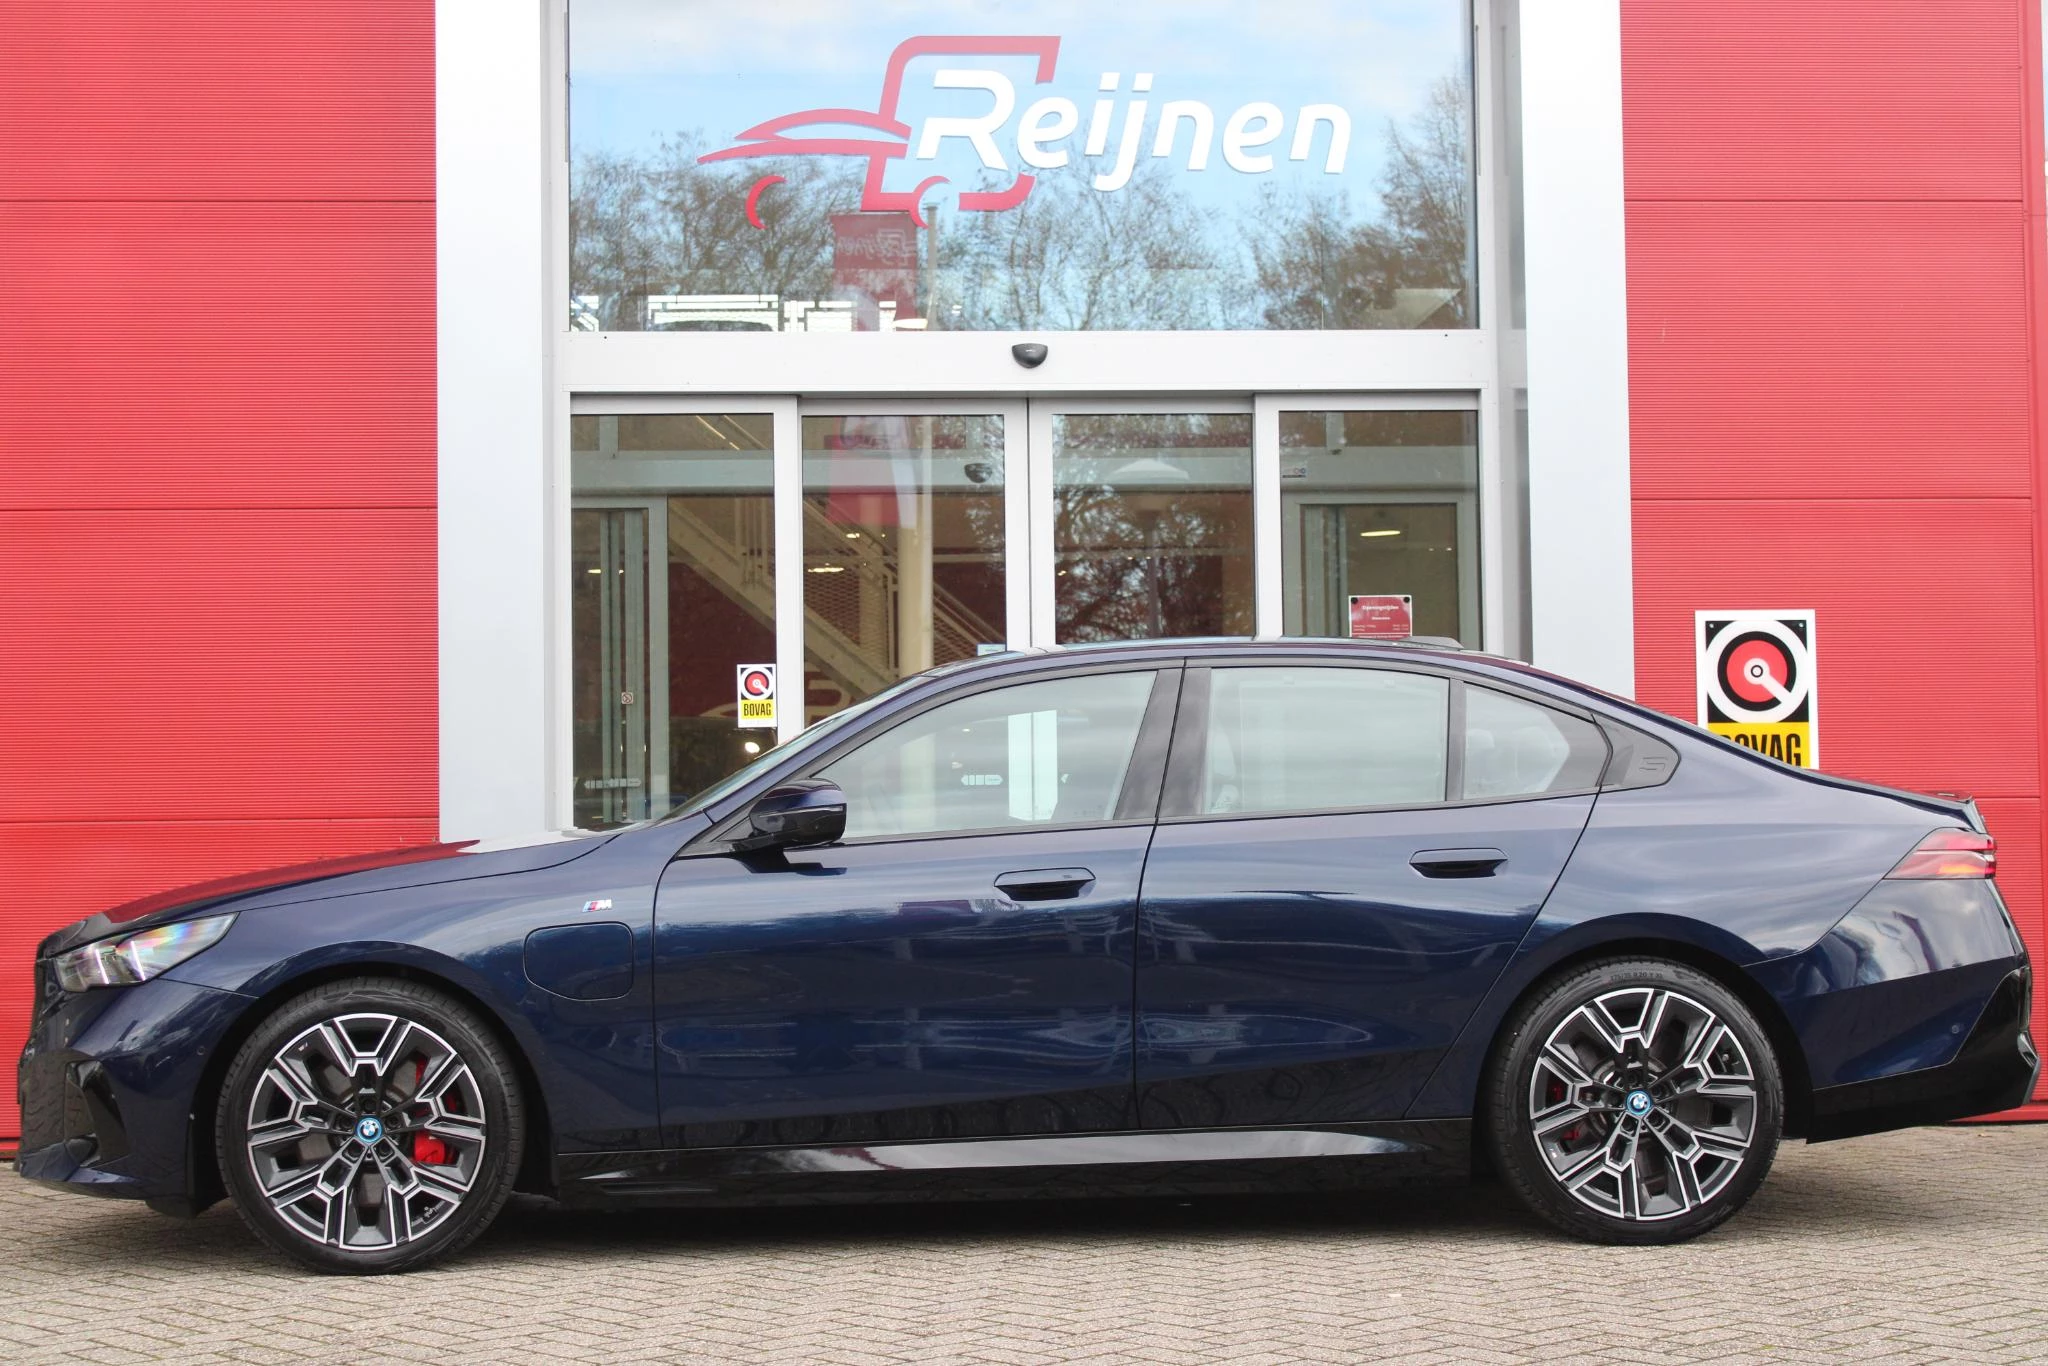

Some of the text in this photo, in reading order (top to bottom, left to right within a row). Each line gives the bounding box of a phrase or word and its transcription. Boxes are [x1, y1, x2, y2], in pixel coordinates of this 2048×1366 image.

[916, 69, 1352, 192] Reijnen
[743, 703, 772, 717] BOVAG
[1719, 733, 1802, 767] VAG
